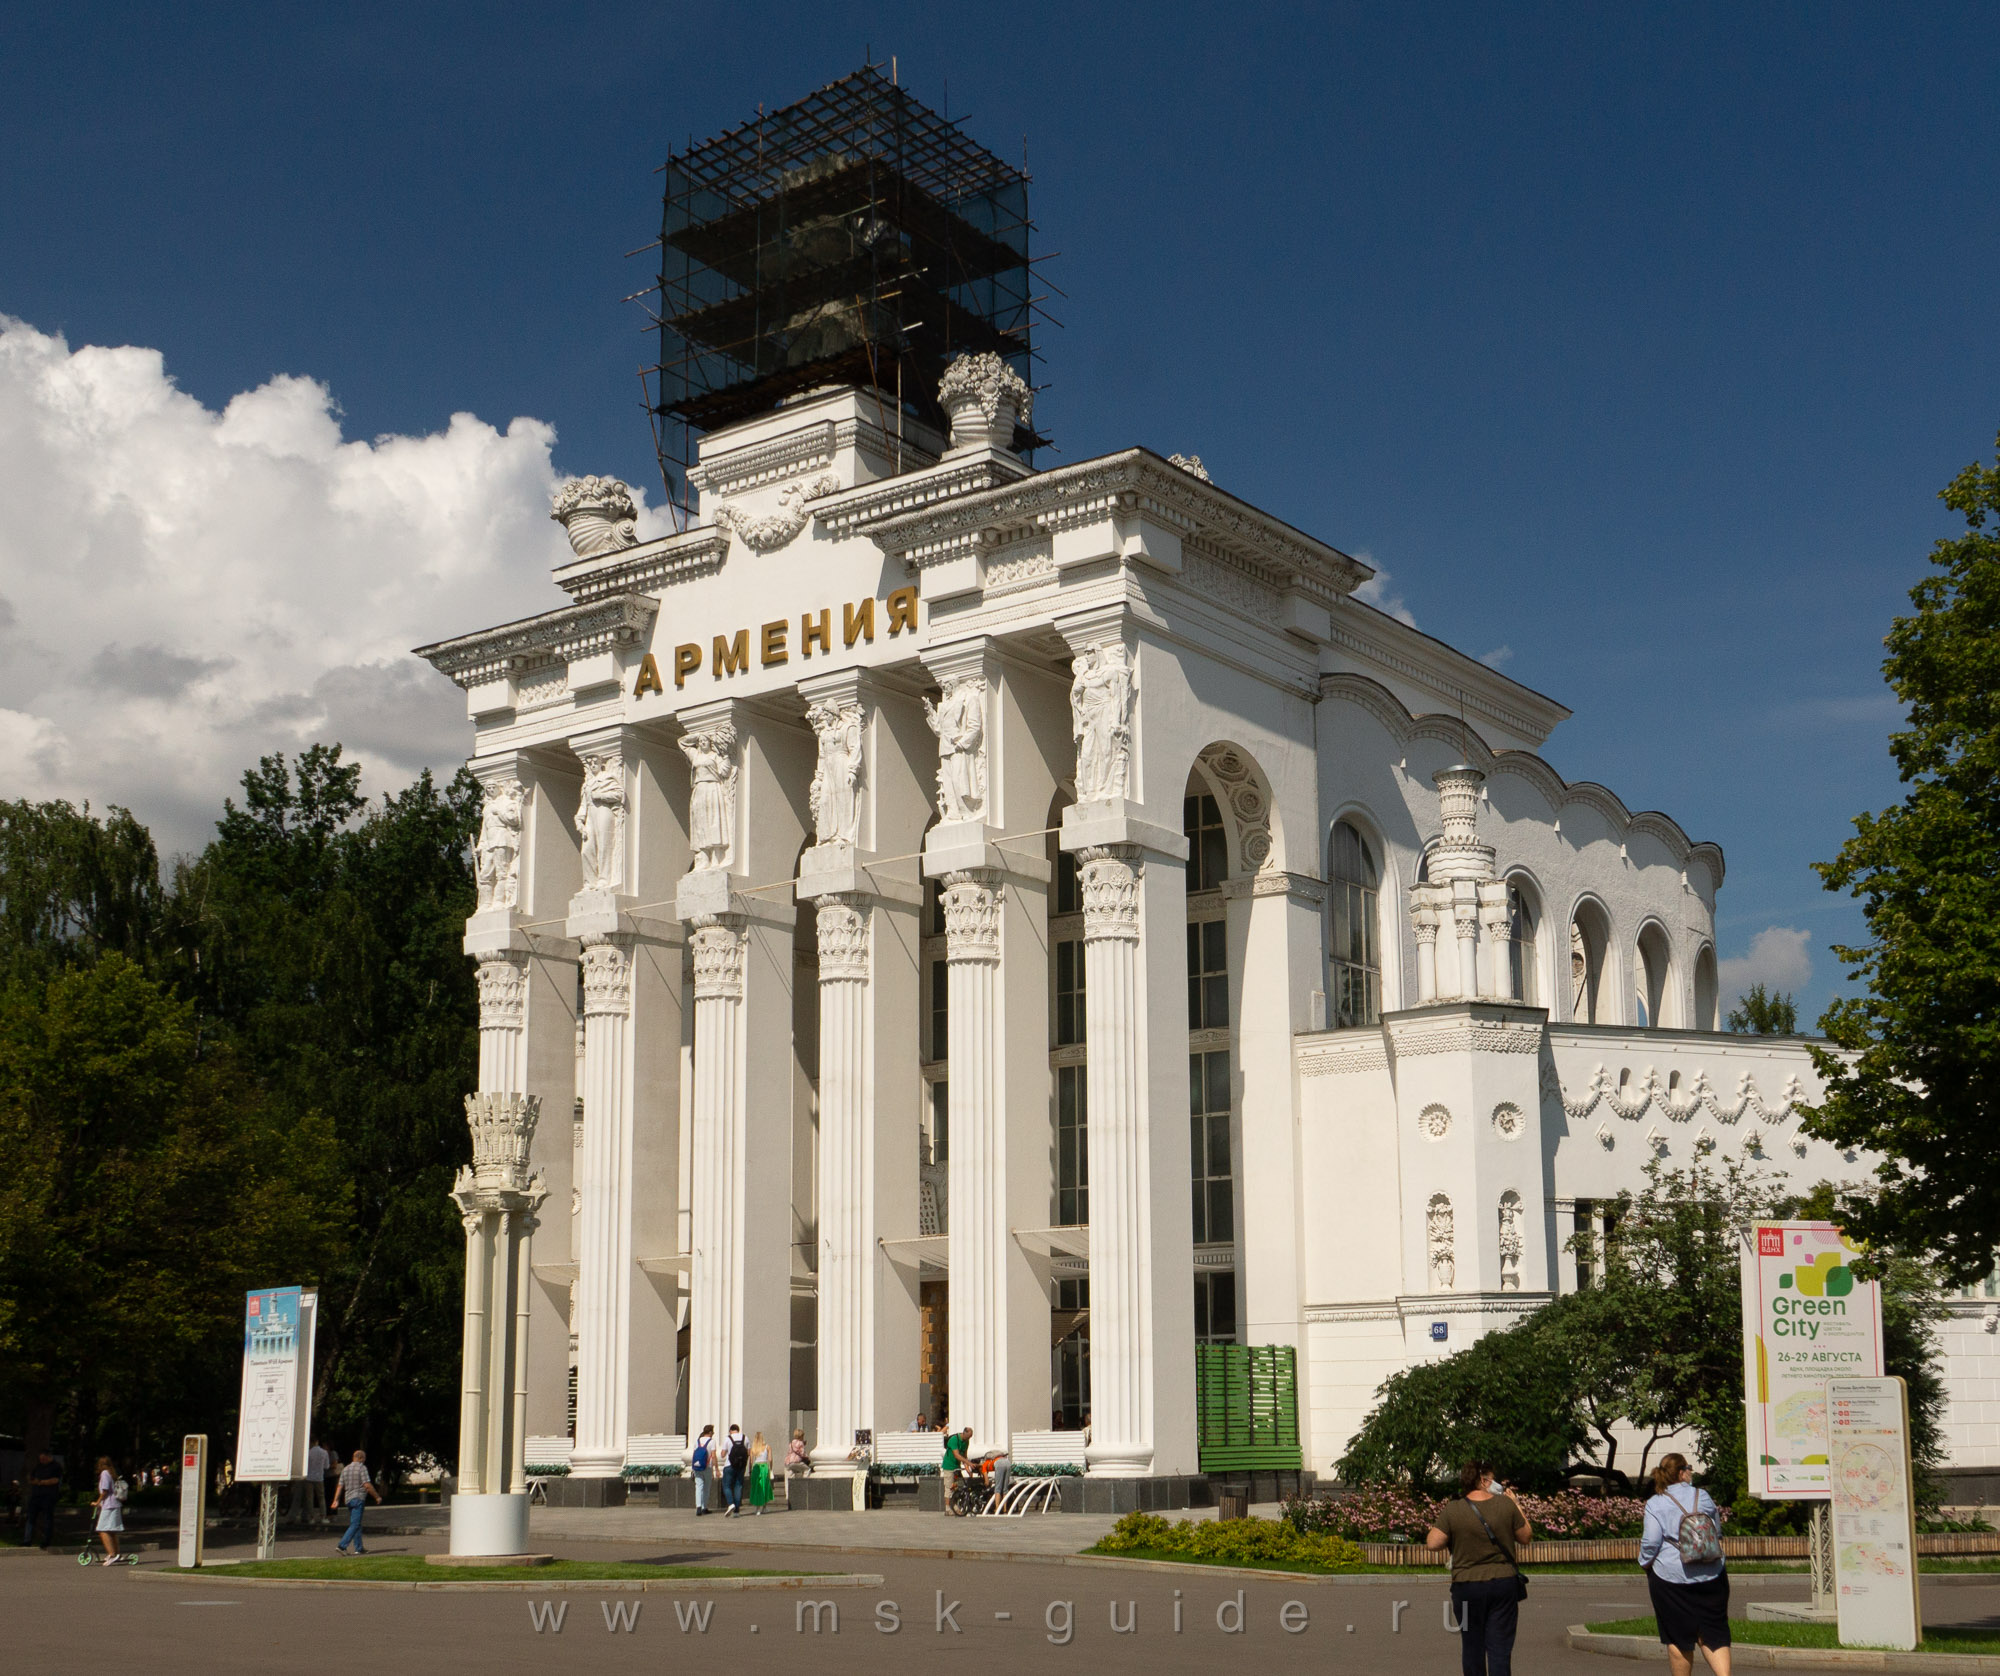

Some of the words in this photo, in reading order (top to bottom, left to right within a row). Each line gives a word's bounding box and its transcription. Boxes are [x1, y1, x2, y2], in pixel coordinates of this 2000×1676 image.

[633, 585, 919, 697] АРМЕНИЯ
[1772, 1296, 1846, 1316] Green
[1433, 1325, 1444, 1334] 68
[1773, 1317, 1820, 1340] City
[1777, 1352, 1808, 1362] 26-29
[1811, 1352, 1862, 1362] АВГУСТА
